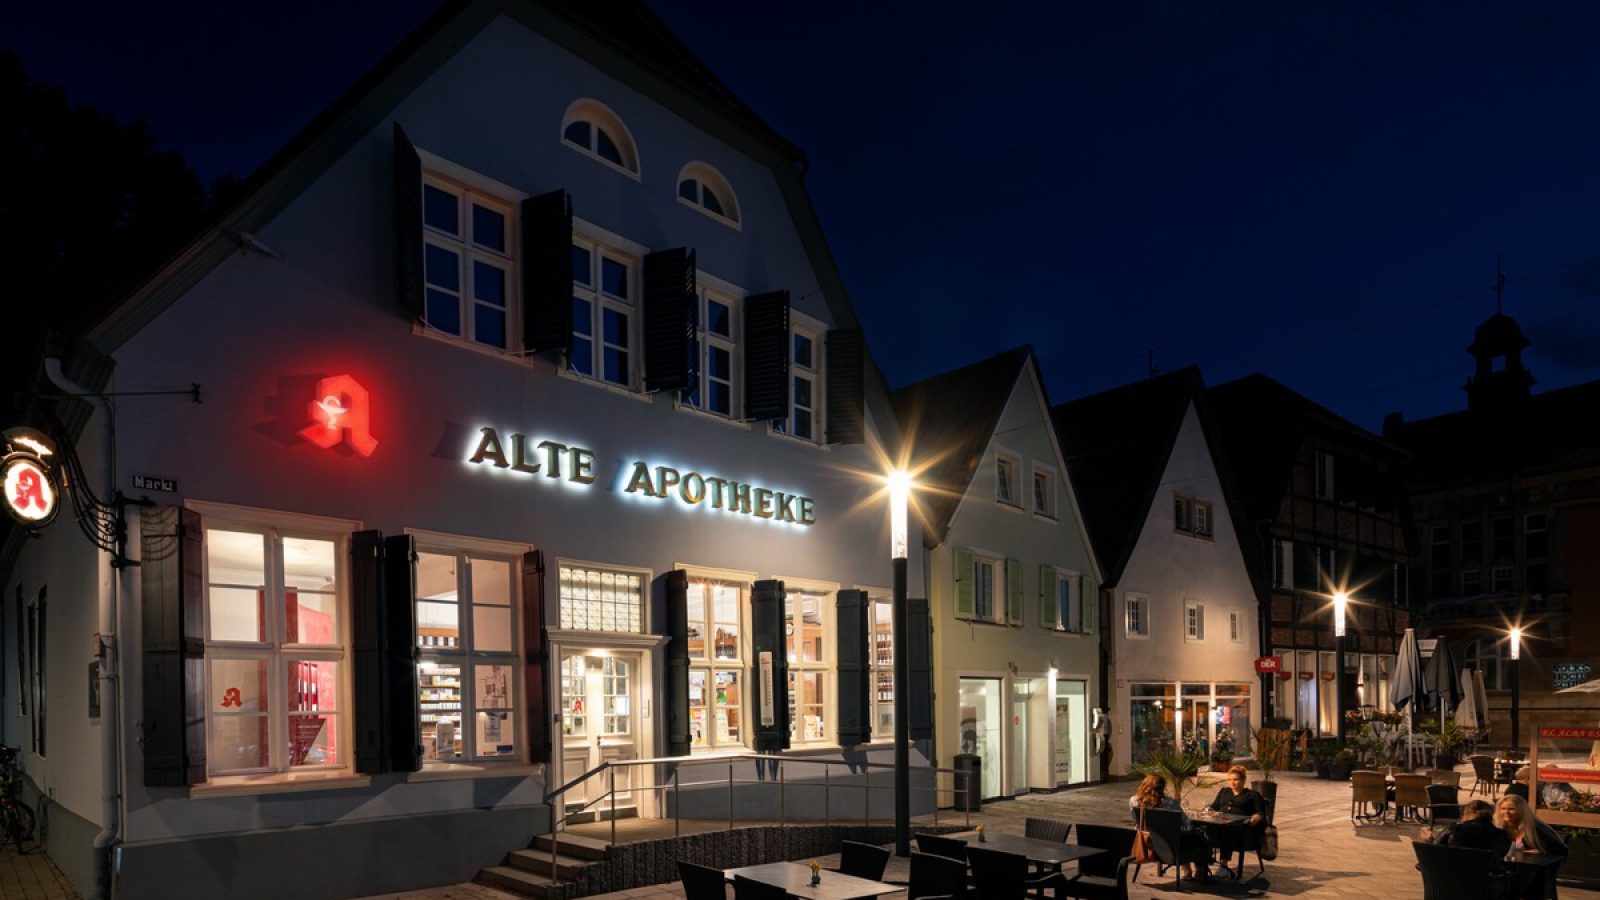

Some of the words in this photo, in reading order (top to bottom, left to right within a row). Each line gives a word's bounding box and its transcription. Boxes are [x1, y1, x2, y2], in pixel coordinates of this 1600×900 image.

[135, 475, 173, 491] Markt
[469, 427, 595, 485] ALTE
[624, 461, 816, 525] APOTHEKE
